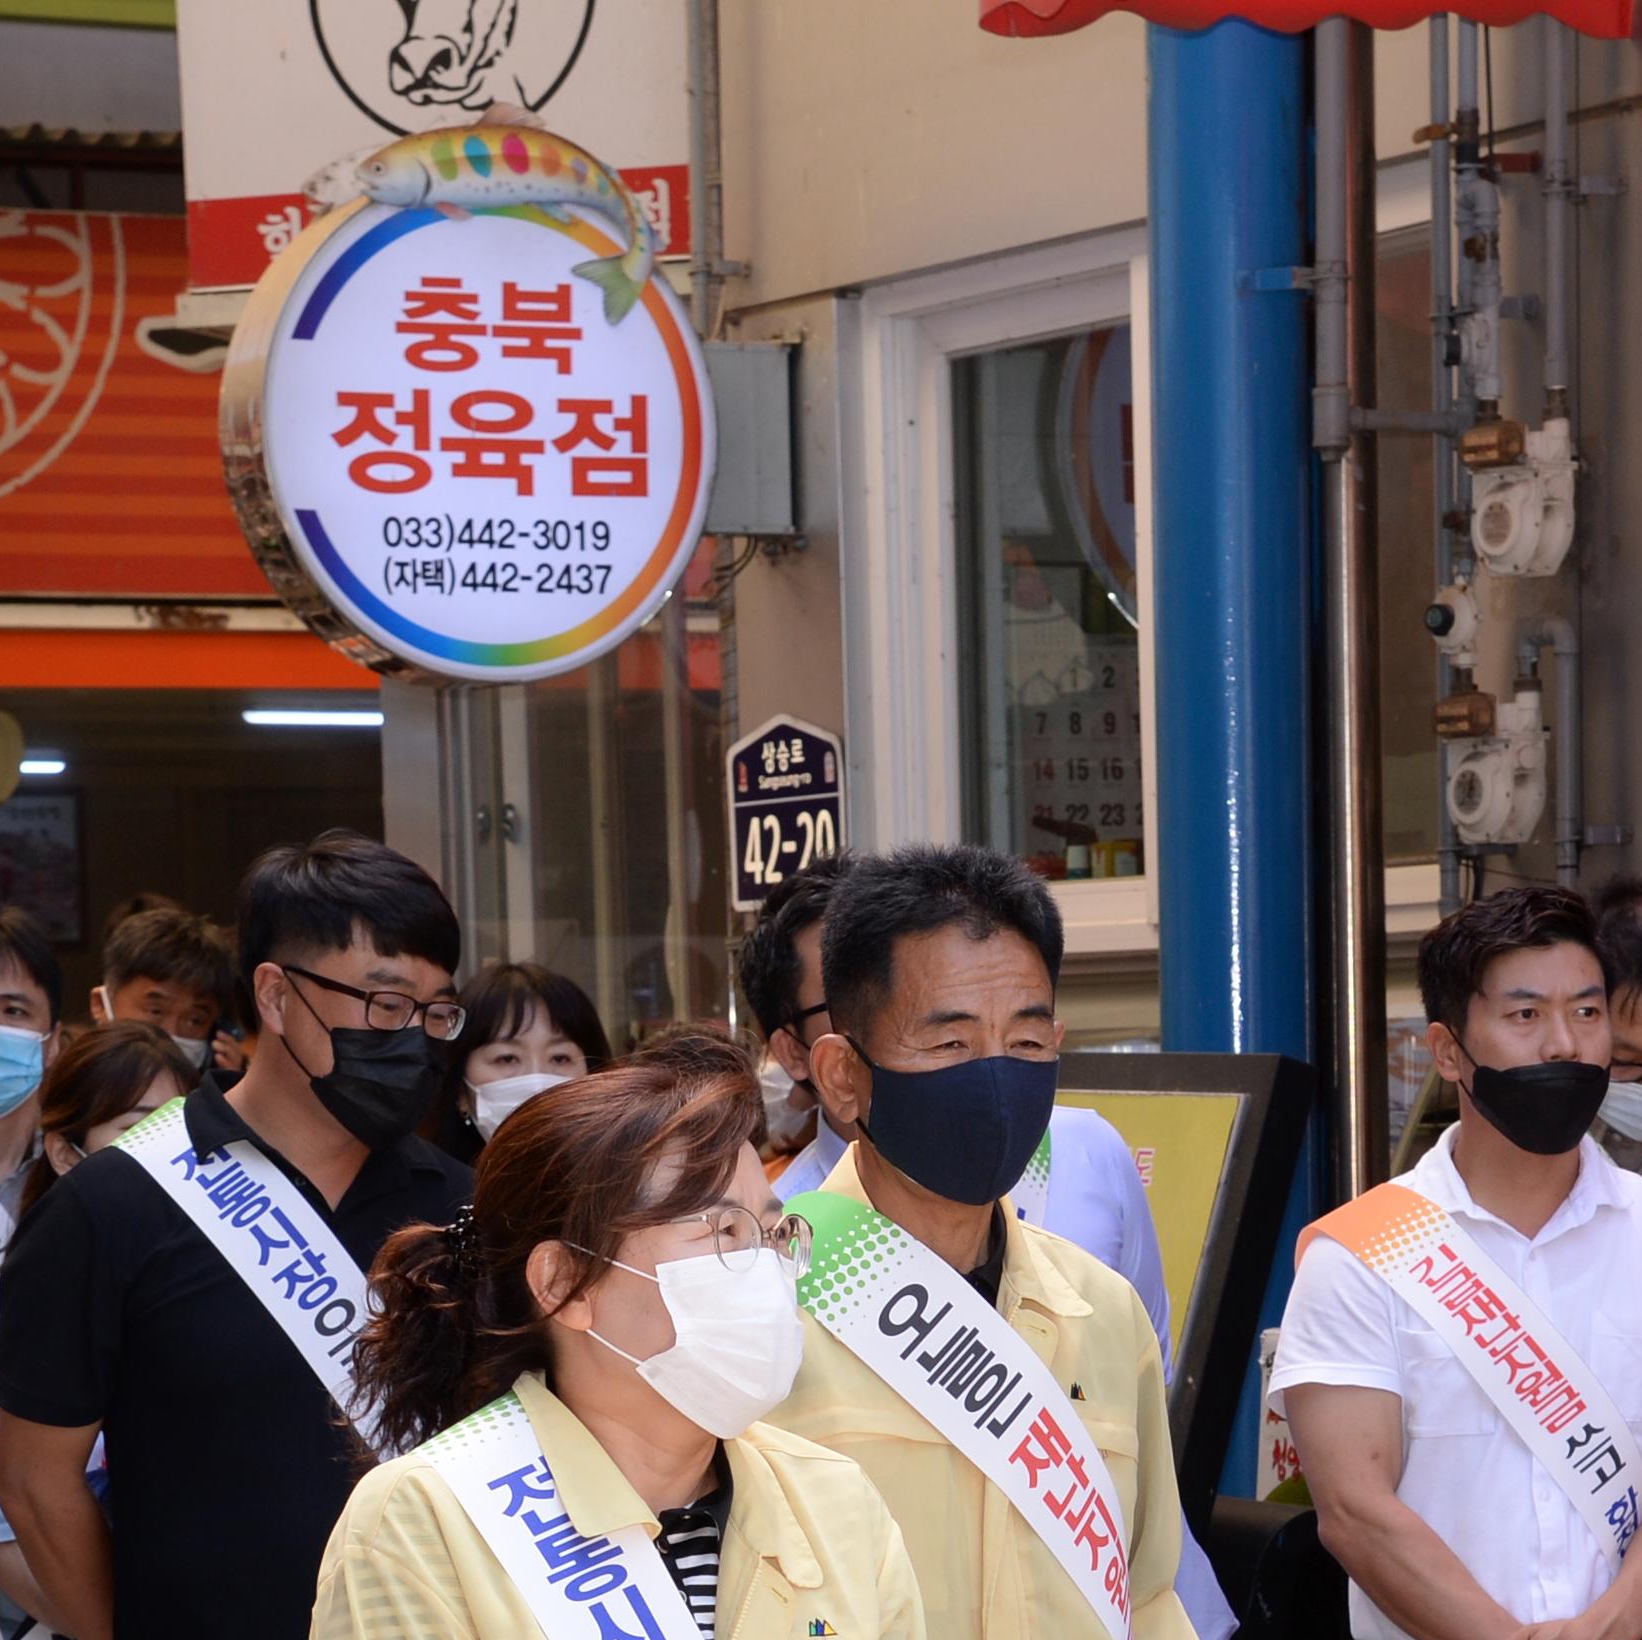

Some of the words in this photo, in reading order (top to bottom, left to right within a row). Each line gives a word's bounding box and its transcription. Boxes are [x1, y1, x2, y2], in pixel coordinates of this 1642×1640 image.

[395, 276, 583, 376] 충북
[331, 388, 649, 497] 정육점
[383, 514, 611, 552] 033)442-3019
[383, 556, 613, 596] (자택)442-2437
[1101, 666, 1115, 689] 2
[1035, 712, 1048, 735] 7
[1069, 711, 1082, 735] 8
[1103, 712, 1117, 735] 9
[761, 737, 806, 774] 상승로
[1033, 757, 1055, 781] 14
[1066, 757, 1090, 781] 15
[1100, 757, 1125, 781] 16
[1100, 803, 1126, 827] 23
[743, 808, 836, 885] 42-20
[170, 1145, 361, 1380] 전통시장으
[877, 1283, 1034, 1440] 오늘은
[1408, 1242, 1588, 1435] 긴급재난지원금
[1565, 1423, 1627, 1495] 쓰고
